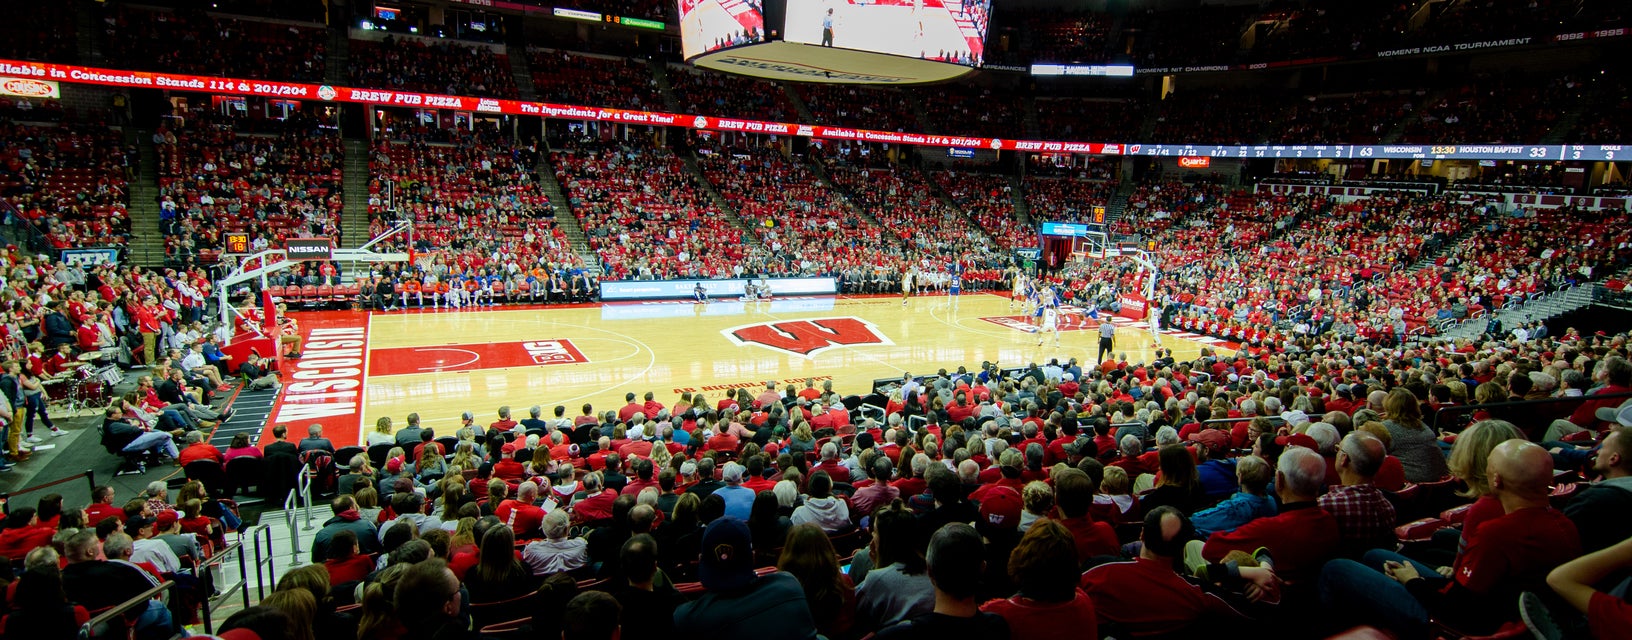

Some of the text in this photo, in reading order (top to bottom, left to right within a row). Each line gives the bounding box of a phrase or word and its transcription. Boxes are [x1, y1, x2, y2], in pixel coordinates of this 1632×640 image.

[1556, 28, 1624, 41] 1992 1995
[1378, 37, 1532, 57] WOMEN'S NCAA TOURNAMENT
[50, 68, 66, 78] in
[70, 70, 152, 85] Concession
[156, 77, 204, 89] Stands
[209, 80, 234, 90] 114
[238, 83, 250, 92] &
[254, 84, 307, 96] 201/204
[350, 90, 462, 108] BREW PUB PIZZA
[520, 104, 539, 113] The
[542, 106, 596, 118] Ingredients
[596, 110, 612, 120] for
[623, 112, 648, 122] Great
[650, 114, 674, 124] Time!
[718, 120, 788, 132] BREW PUB PIZZA
[822, 128, 855, 138] Available
[866, 132, 902, 142] Concession
[902, 135, 925, 143] Stands
[926, 136, 940, 144] 114
[950, 138, 982, 146] 201/204
[1015, 141, 1090, 152] BREW PUB PIZZA
[1360, 147, 1373, 157] 63
[1430, 146, 1456, 154] 13:30
[1530, 148, 1546, 158] 33
[1572, 151, 1580, 159] 3
[1606, 151, 1614, 159] 3
[1182, 158, 1206, 166] Quartz
[234, 243, 244, 252] 18
[275, 327, 365, 424] WISCONSIN
